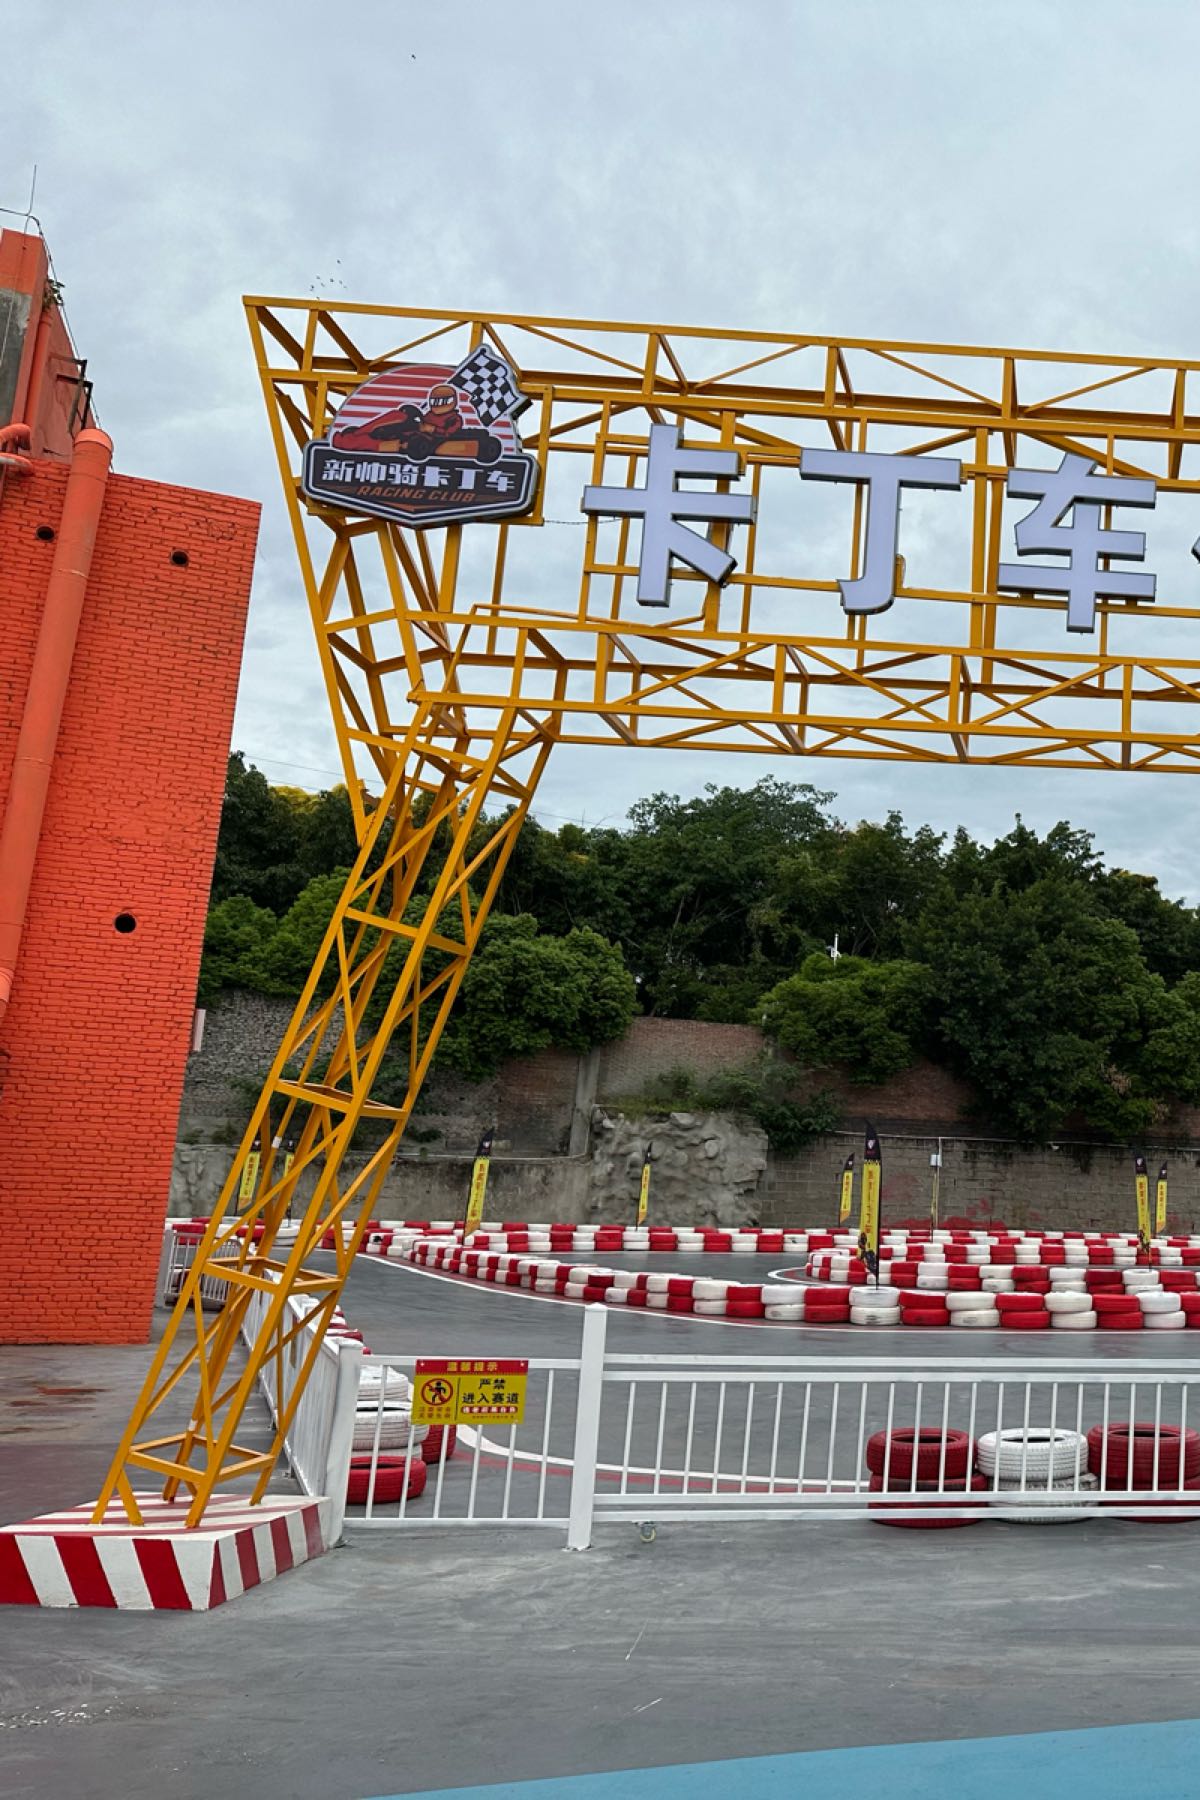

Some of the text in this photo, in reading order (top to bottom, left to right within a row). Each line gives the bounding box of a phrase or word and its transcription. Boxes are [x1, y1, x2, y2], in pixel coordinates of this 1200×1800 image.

[322, 458, 517, 493] 新帅骑卡丁车
[356, 485, 477, 503] RACING CLUB
[478, 1378, 506, 1390] 严禁
[462, 1392, 519, 1405] 进入赛道
